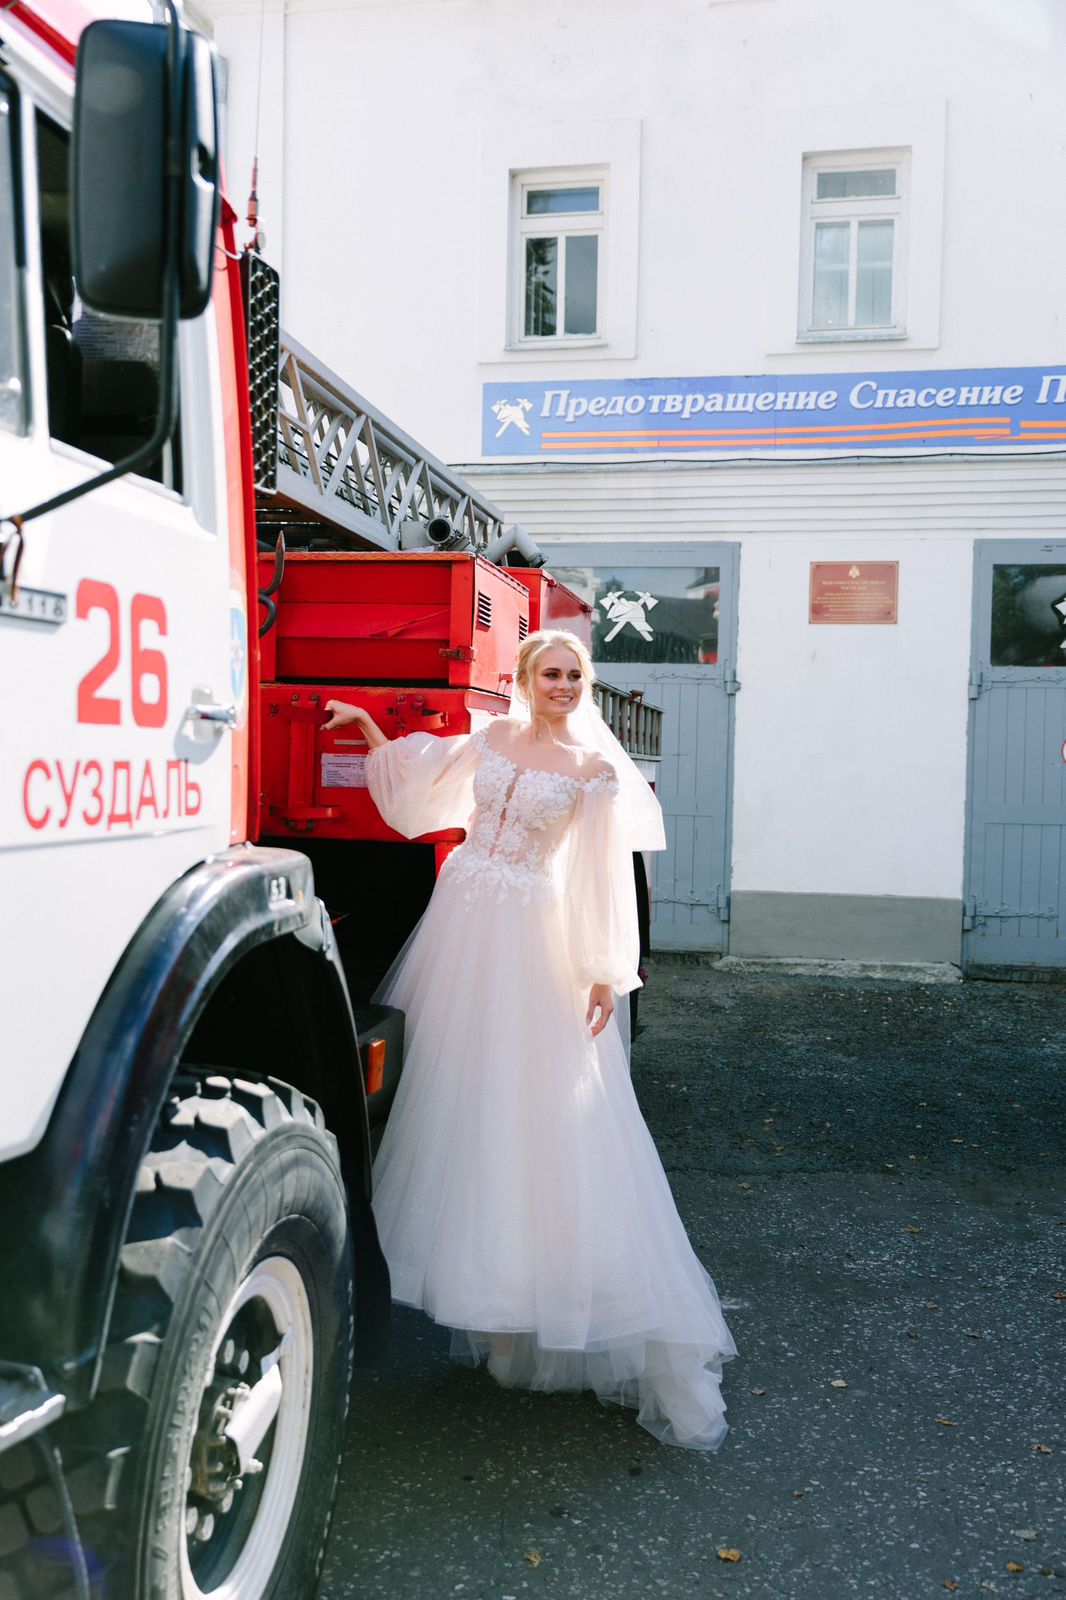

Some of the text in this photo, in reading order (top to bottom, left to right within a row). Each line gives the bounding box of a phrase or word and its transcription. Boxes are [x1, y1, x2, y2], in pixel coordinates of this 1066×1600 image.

[540, 390, 839, 422] Предотвращение
[849, 381, 1023, 410] Спасение
[75, 578, 169, 729] 26
[22, 758, 203, 832] СУЗДАЛЬ
